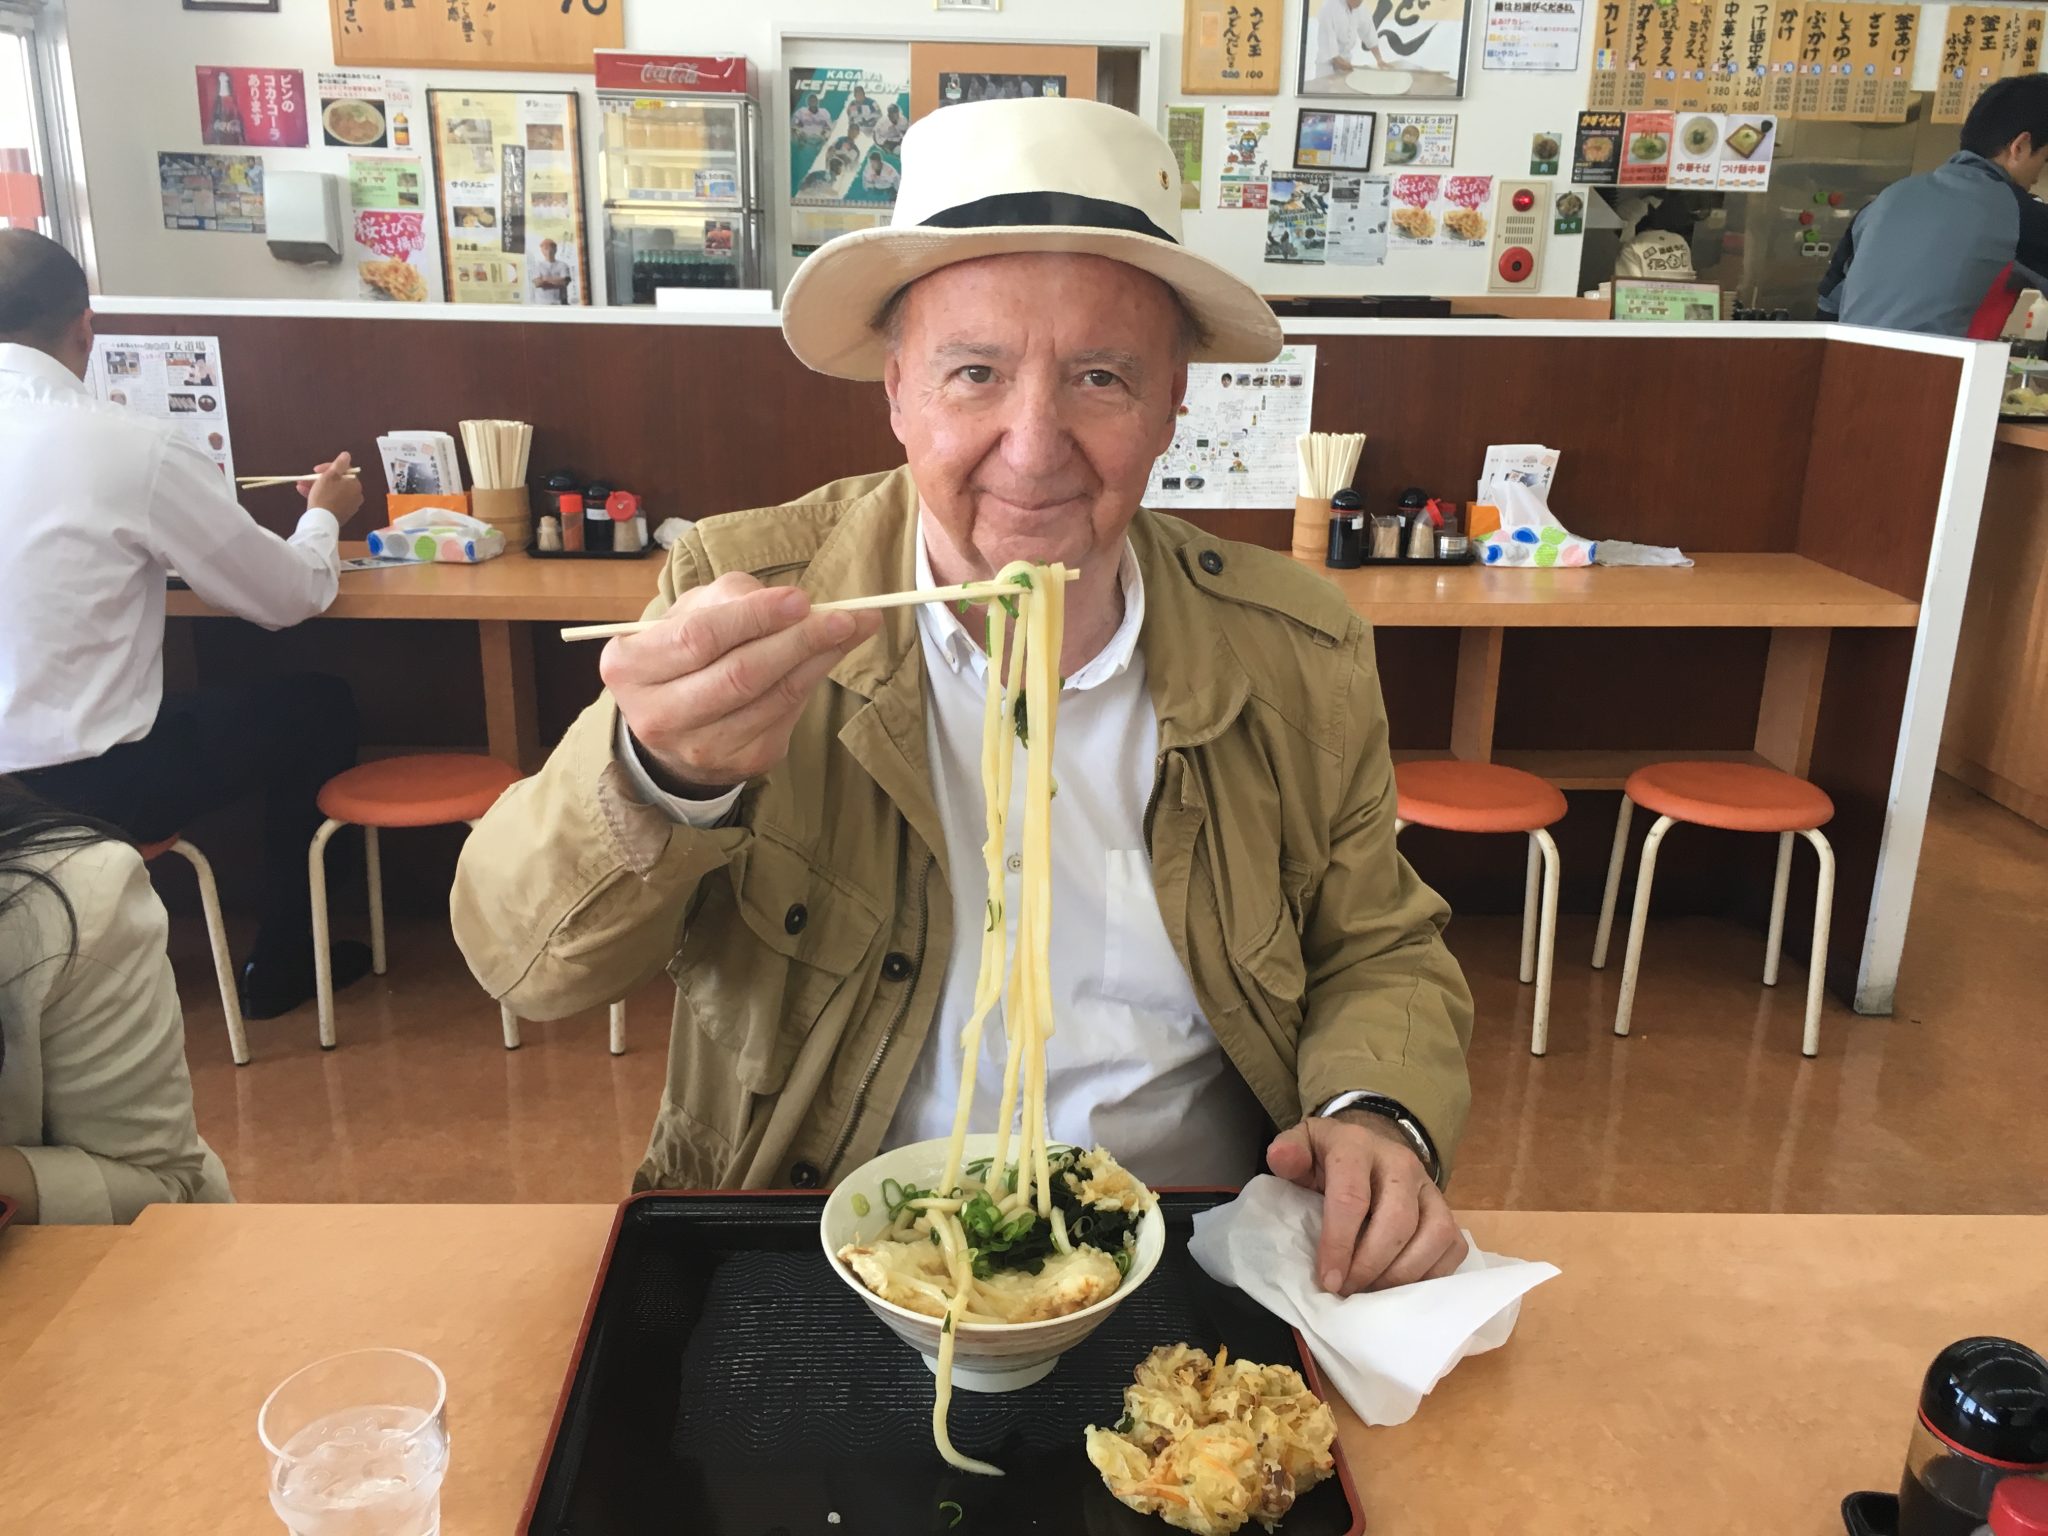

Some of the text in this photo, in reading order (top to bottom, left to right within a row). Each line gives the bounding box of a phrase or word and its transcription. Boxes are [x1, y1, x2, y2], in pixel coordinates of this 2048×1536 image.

[1604, 3, 1619, 49] カレー
[1778, 8, 1798, 41] かけ
[1245, 70, 1263, 79] 100
[280, 75, 294, 112] ビンの
[1676, 163, 1711, 173] 中華そば
[1722, 164, 1766, 174] つけ麺中華
